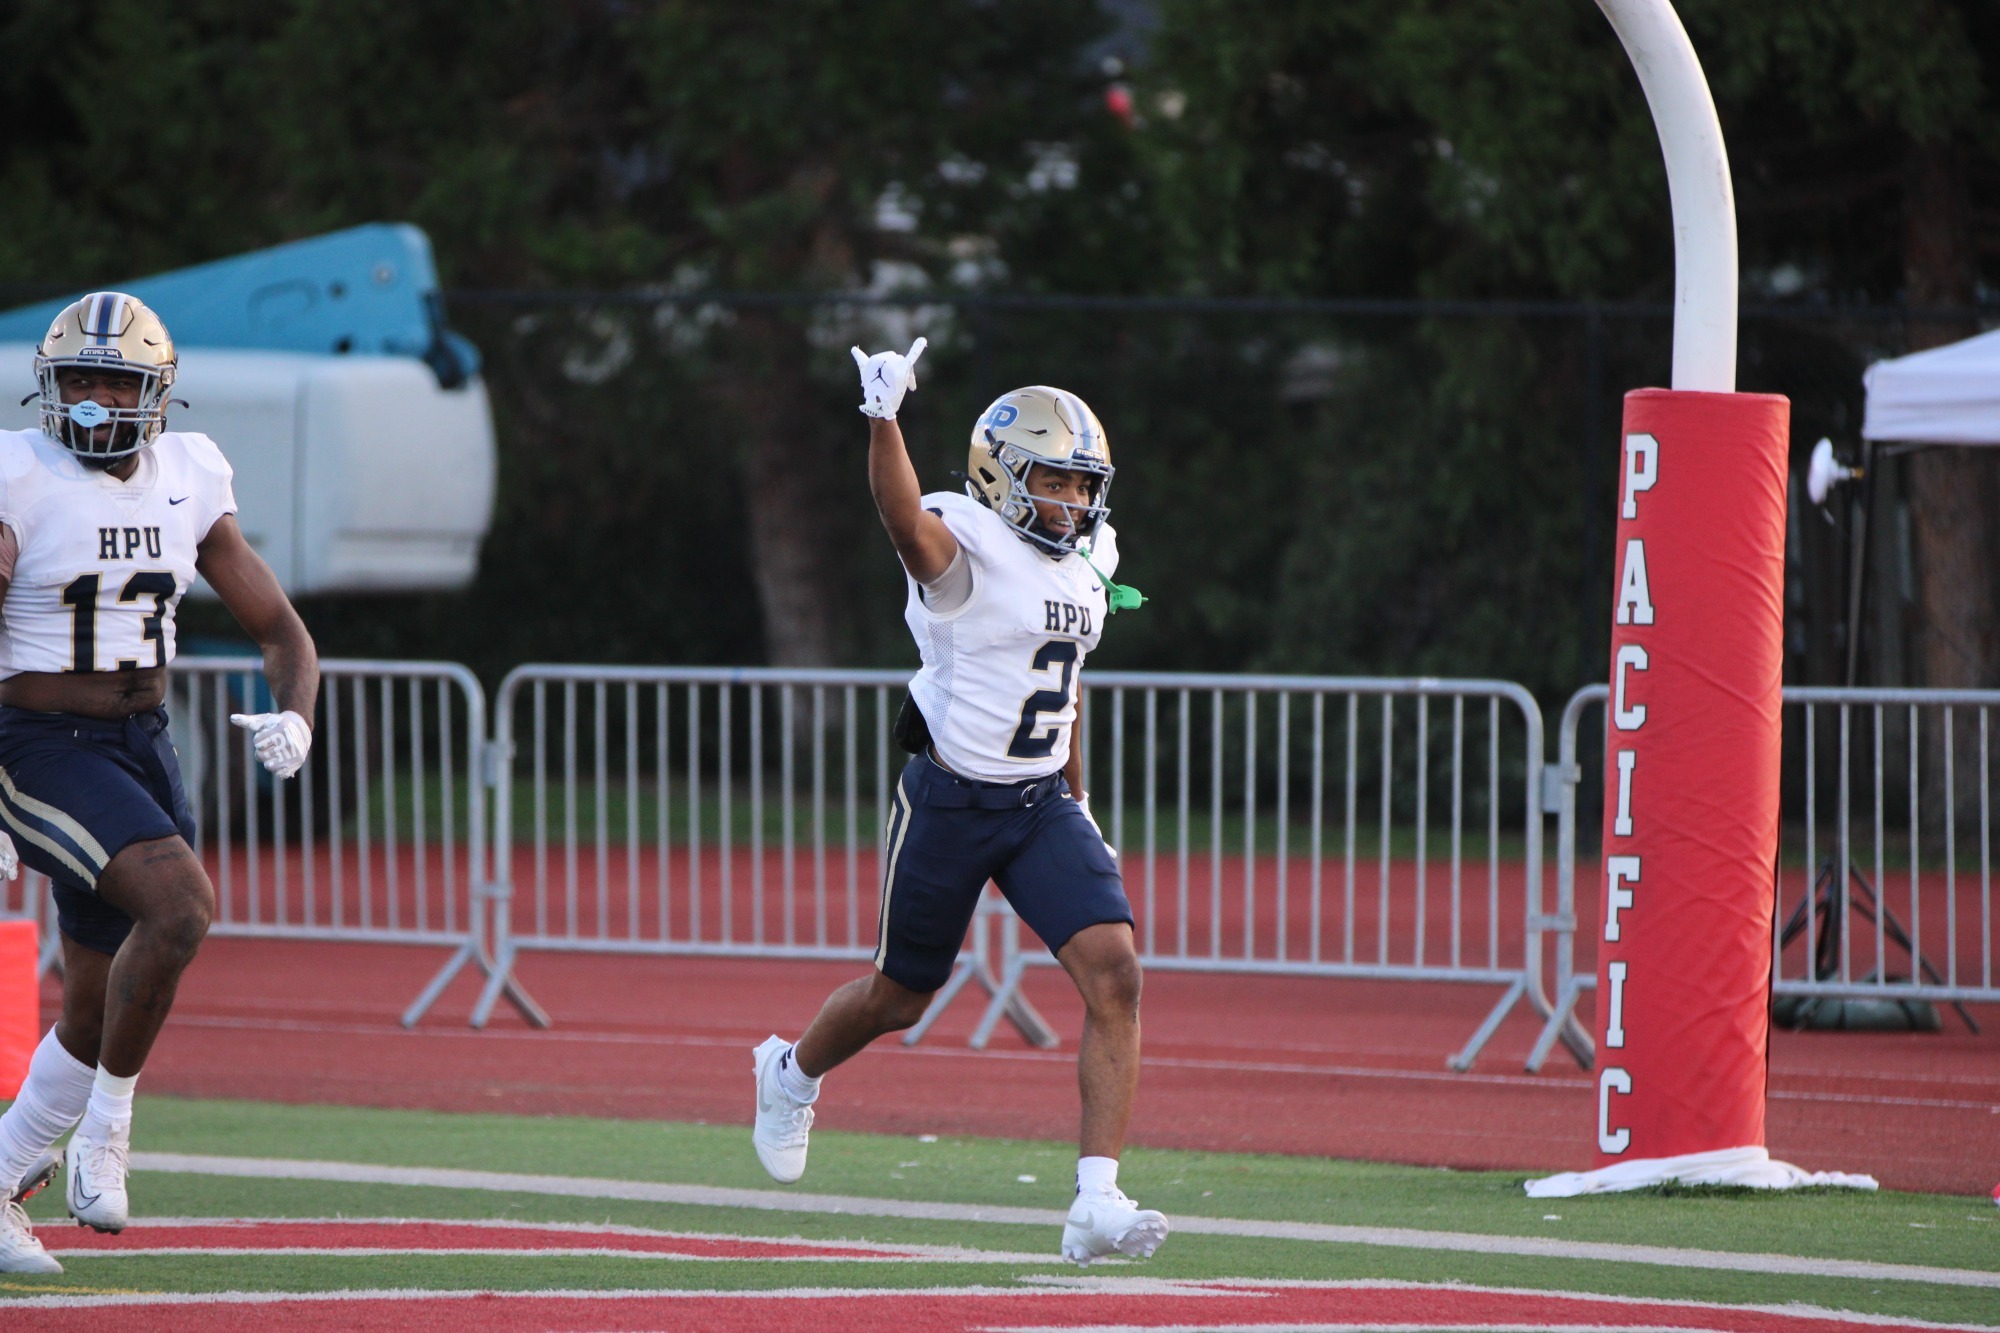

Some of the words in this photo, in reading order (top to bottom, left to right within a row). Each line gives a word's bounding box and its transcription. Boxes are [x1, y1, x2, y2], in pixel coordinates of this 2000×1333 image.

[98, 526, 162, 560] HPU
[60, 570, 178, 673] 13
[1044, 599, 1092, 636] HPU
[1004, 637, 1078, 764] 2
[1598, 432, 1660, 1154] PACIFIC
